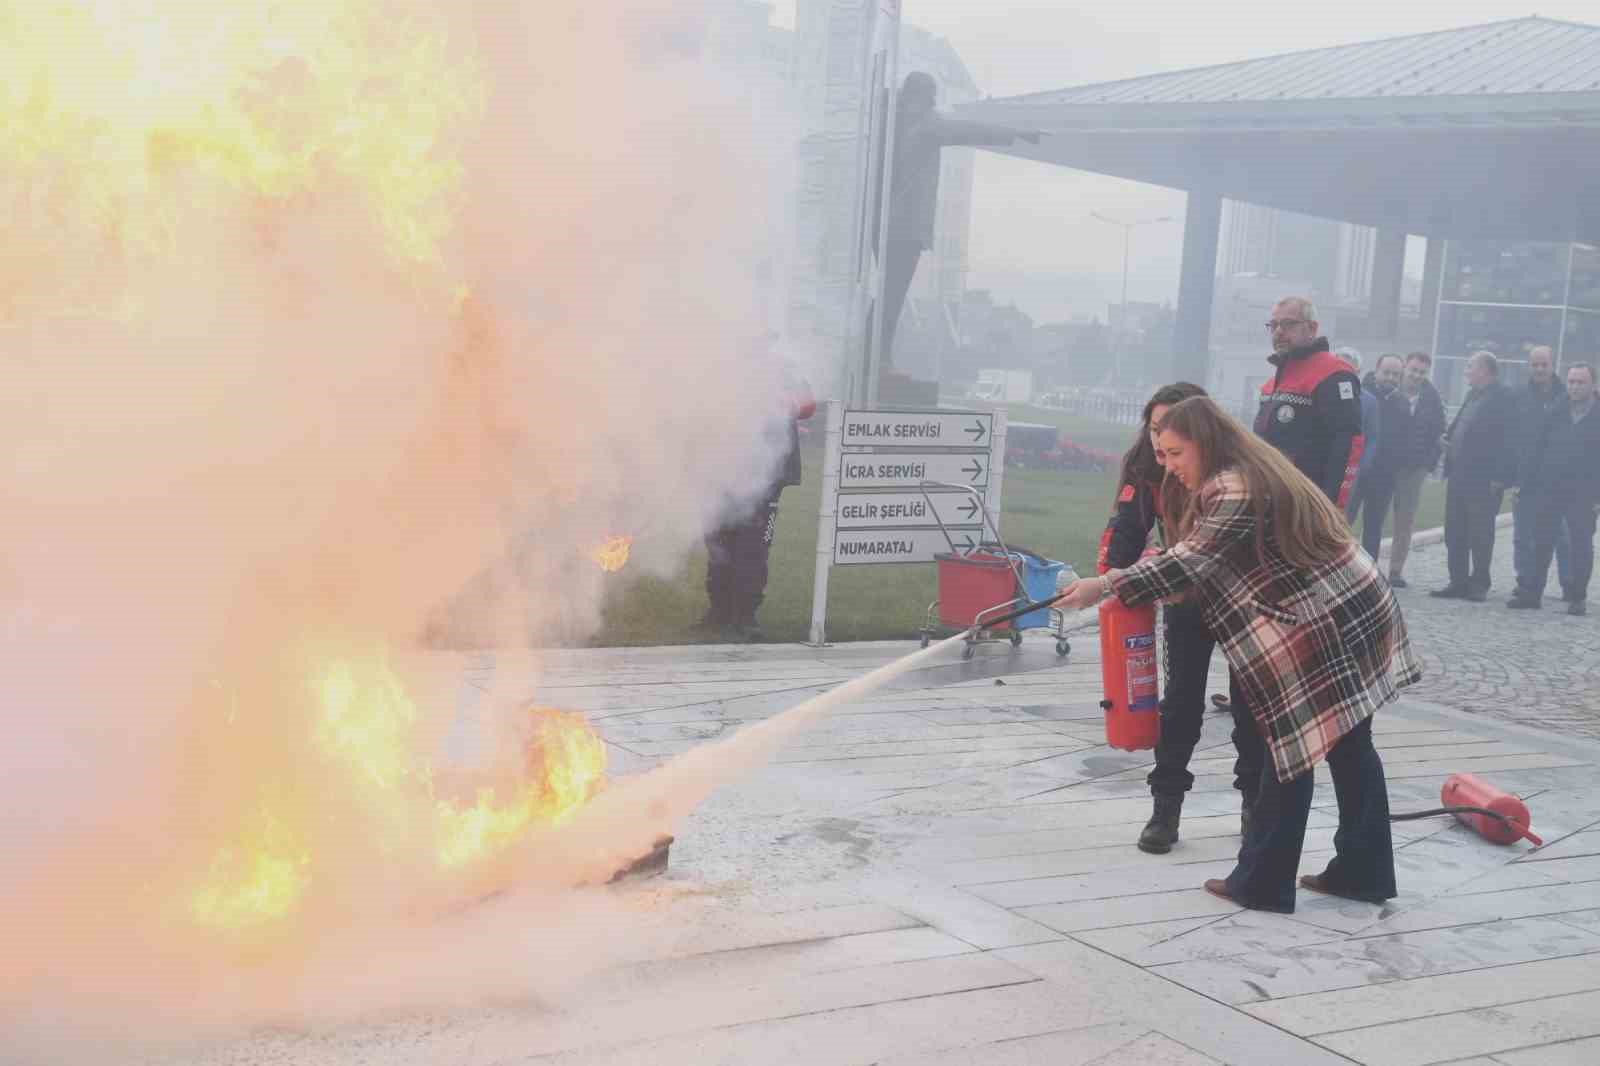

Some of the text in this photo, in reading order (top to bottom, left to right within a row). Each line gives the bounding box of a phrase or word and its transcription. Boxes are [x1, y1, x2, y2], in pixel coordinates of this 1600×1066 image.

[848, 422, 941, 438] EMLAK SERVİSİ
[846, 462, 925, 479] İCRA SERVİSİ
[842, 500, 926, 519] GELİR ŞEFLİĞİ
[839, 540, 914, 556] NUMARATAJ
